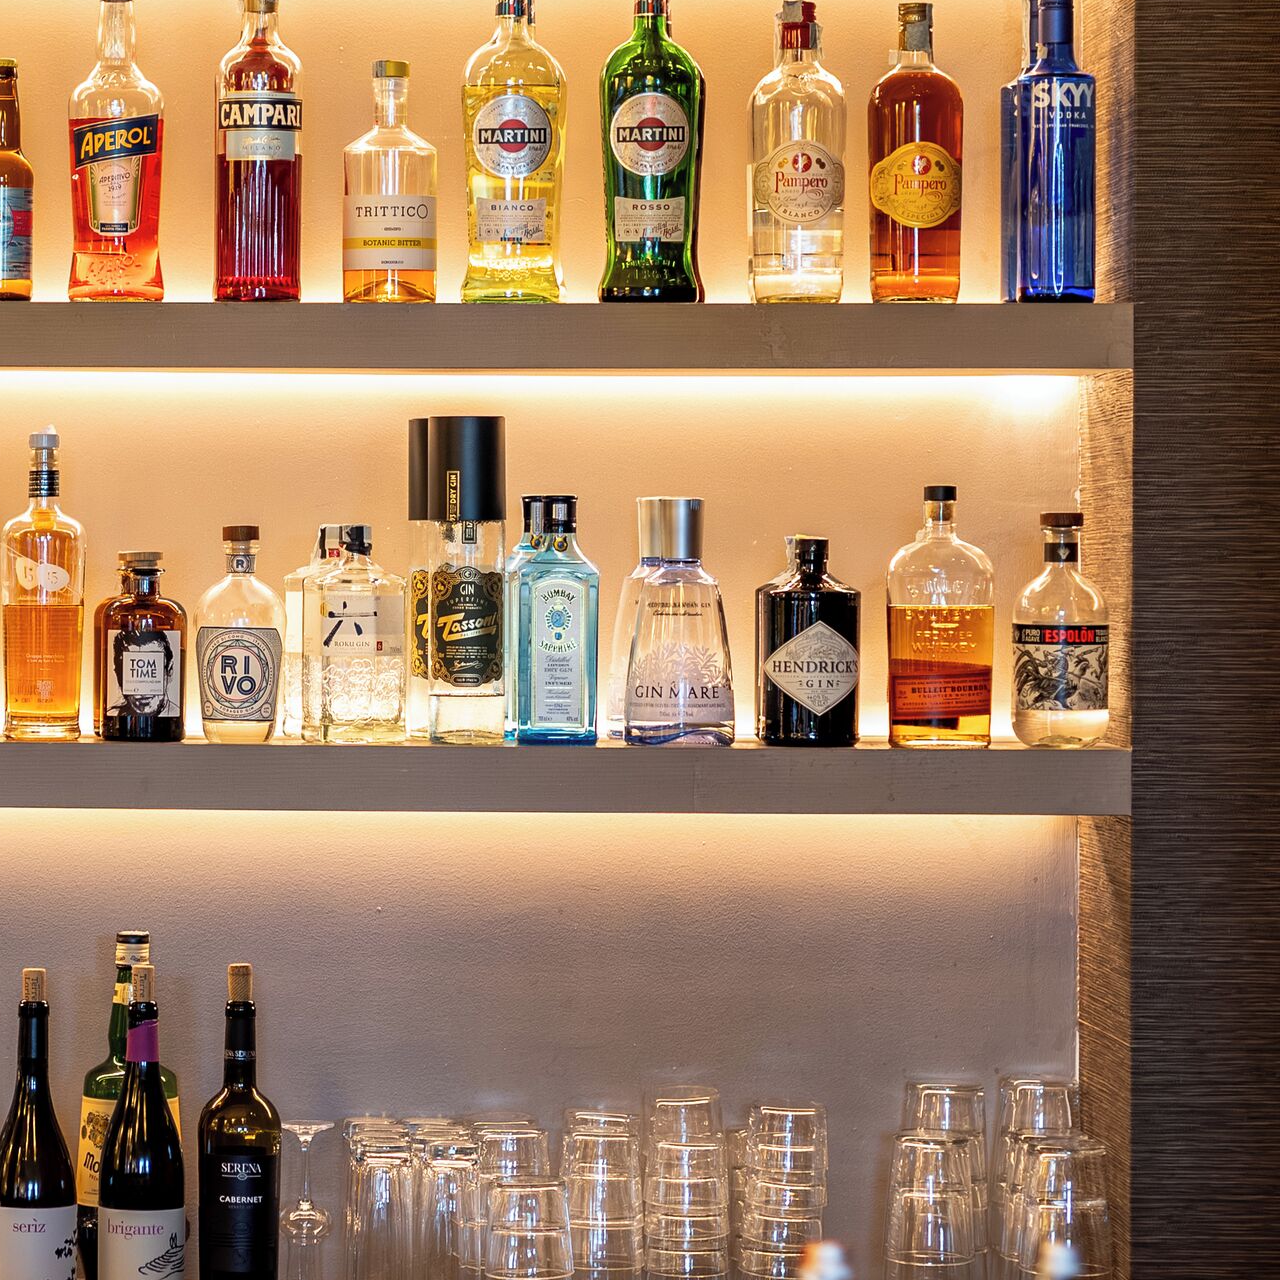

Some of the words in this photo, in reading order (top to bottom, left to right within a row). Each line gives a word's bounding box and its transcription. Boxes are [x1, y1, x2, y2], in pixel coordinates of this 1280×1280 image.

[1033, 82, 1093, 108] SKYY
[221, 104, 300, 127] CAMPARI
[1049, 111, 1086, 119] VODKA
[480, 129, 545, 143] MARTINI
[619, 128, 683, 141] MARTINI
[81, 127, 151, 159] APEROL
[774, 171, 828, 194] Pampero
[894, 174, 947, 197] Pampero
[355, 204, 429, 219] TRITTICO
[490, 204, 534, 212] BIANCO
[782, 208, 820, 218] BLANCO
[363, 239, 396, 247] BOTANIC
[397, 239, 422, 247] BITTER
[449, 474, 457, 487] GIN
[449, 488, 457, 504] DRY
[235, 559, 245, 569] R
[459, 583, 475, 595] GIN
[540, 588, 577, 605] BOMBAY
[437, 612, 497, 634] Tassoni
[1025, 629, 1041, 637] PURO
[130, 659, 157, 669] TOM
[772, 660, 859, 674] HENDRICK'S
[130, 669, 157, 679] TIME
[806, 679, 834, 689] GIN
[635, 685, 663, 699] GIN
[669, 686, 720, 700] MARE
[221, 1162, 262, 1174] SERENA
[219, 1195, 263, 1204] CABERNET
[107, 1219, 164, 1240] brigante
